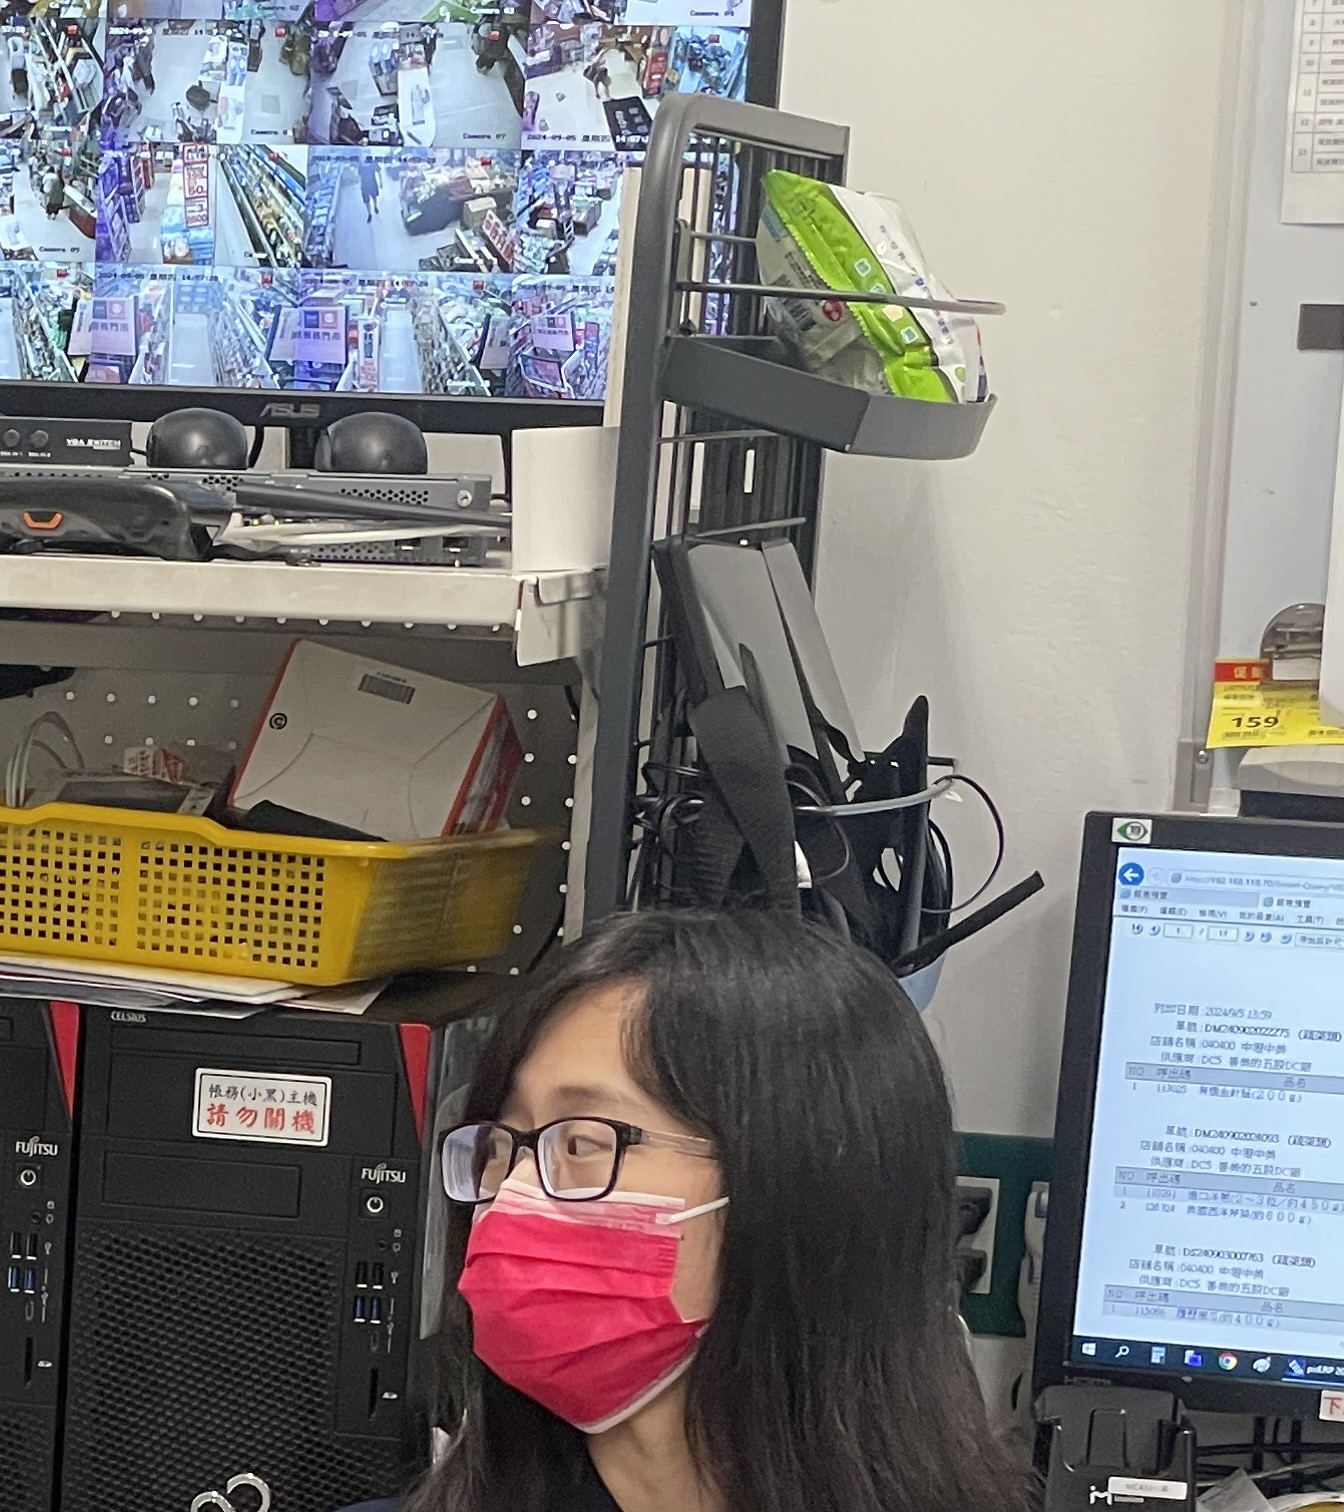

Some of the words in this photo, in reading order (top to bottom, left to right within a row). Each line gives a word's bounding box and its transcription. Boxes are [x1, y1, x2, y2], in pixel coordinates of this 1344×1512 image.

[1232, 717, 1279, 728] 159
[111, 1010, 146, 1023] CELSIUS
[206, 1103, 316, 1134] 請勿關機
[15, 1136, 58, 1157] FUJITSU
[361, 1163, 406, 1184] FUJITSU
